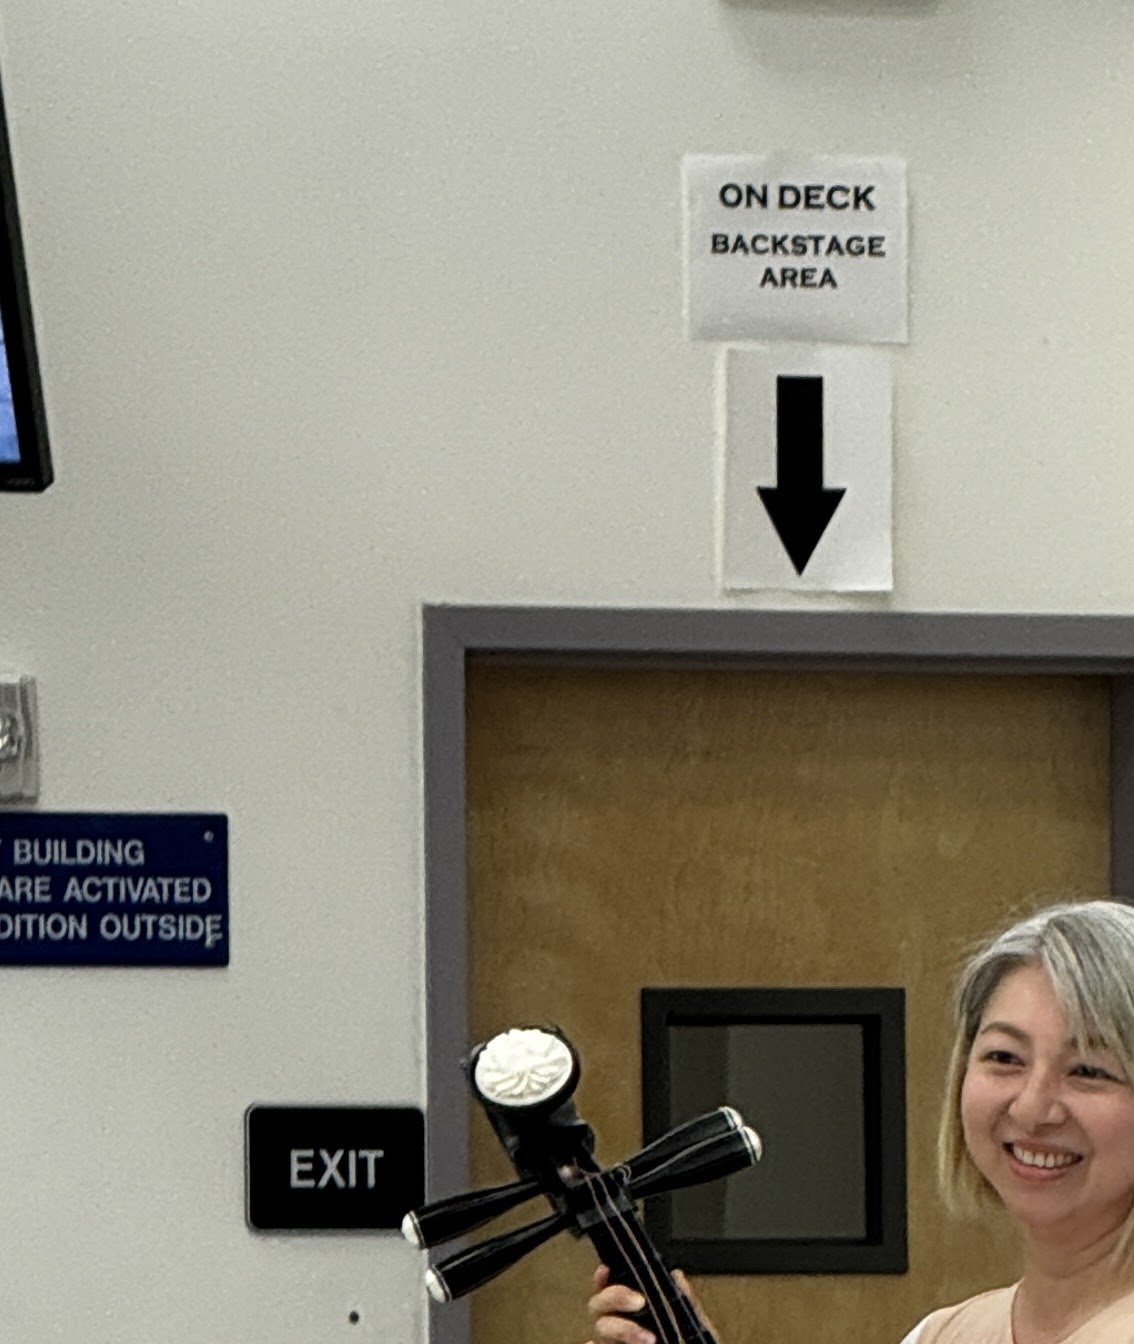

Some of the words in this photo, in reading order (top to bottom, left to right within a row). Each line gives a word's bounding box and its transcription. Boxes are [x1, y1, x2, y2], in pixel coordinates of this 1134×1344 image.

[718, 183, 768, 209] ON
[777, 184, 876, 212] DECK
[711, 233, 886, 258] BACKSTAGE
[759, 267, 838, 289] AREA
[13, 838, 145, 866] BUILDING
[0, 875, 51, 903] ARE
[63, 876, 212, 904] ACTIVATED
[100, 913, 223, 943] OUTSIDE
[290, 1148, 385, 1189] EXIT
